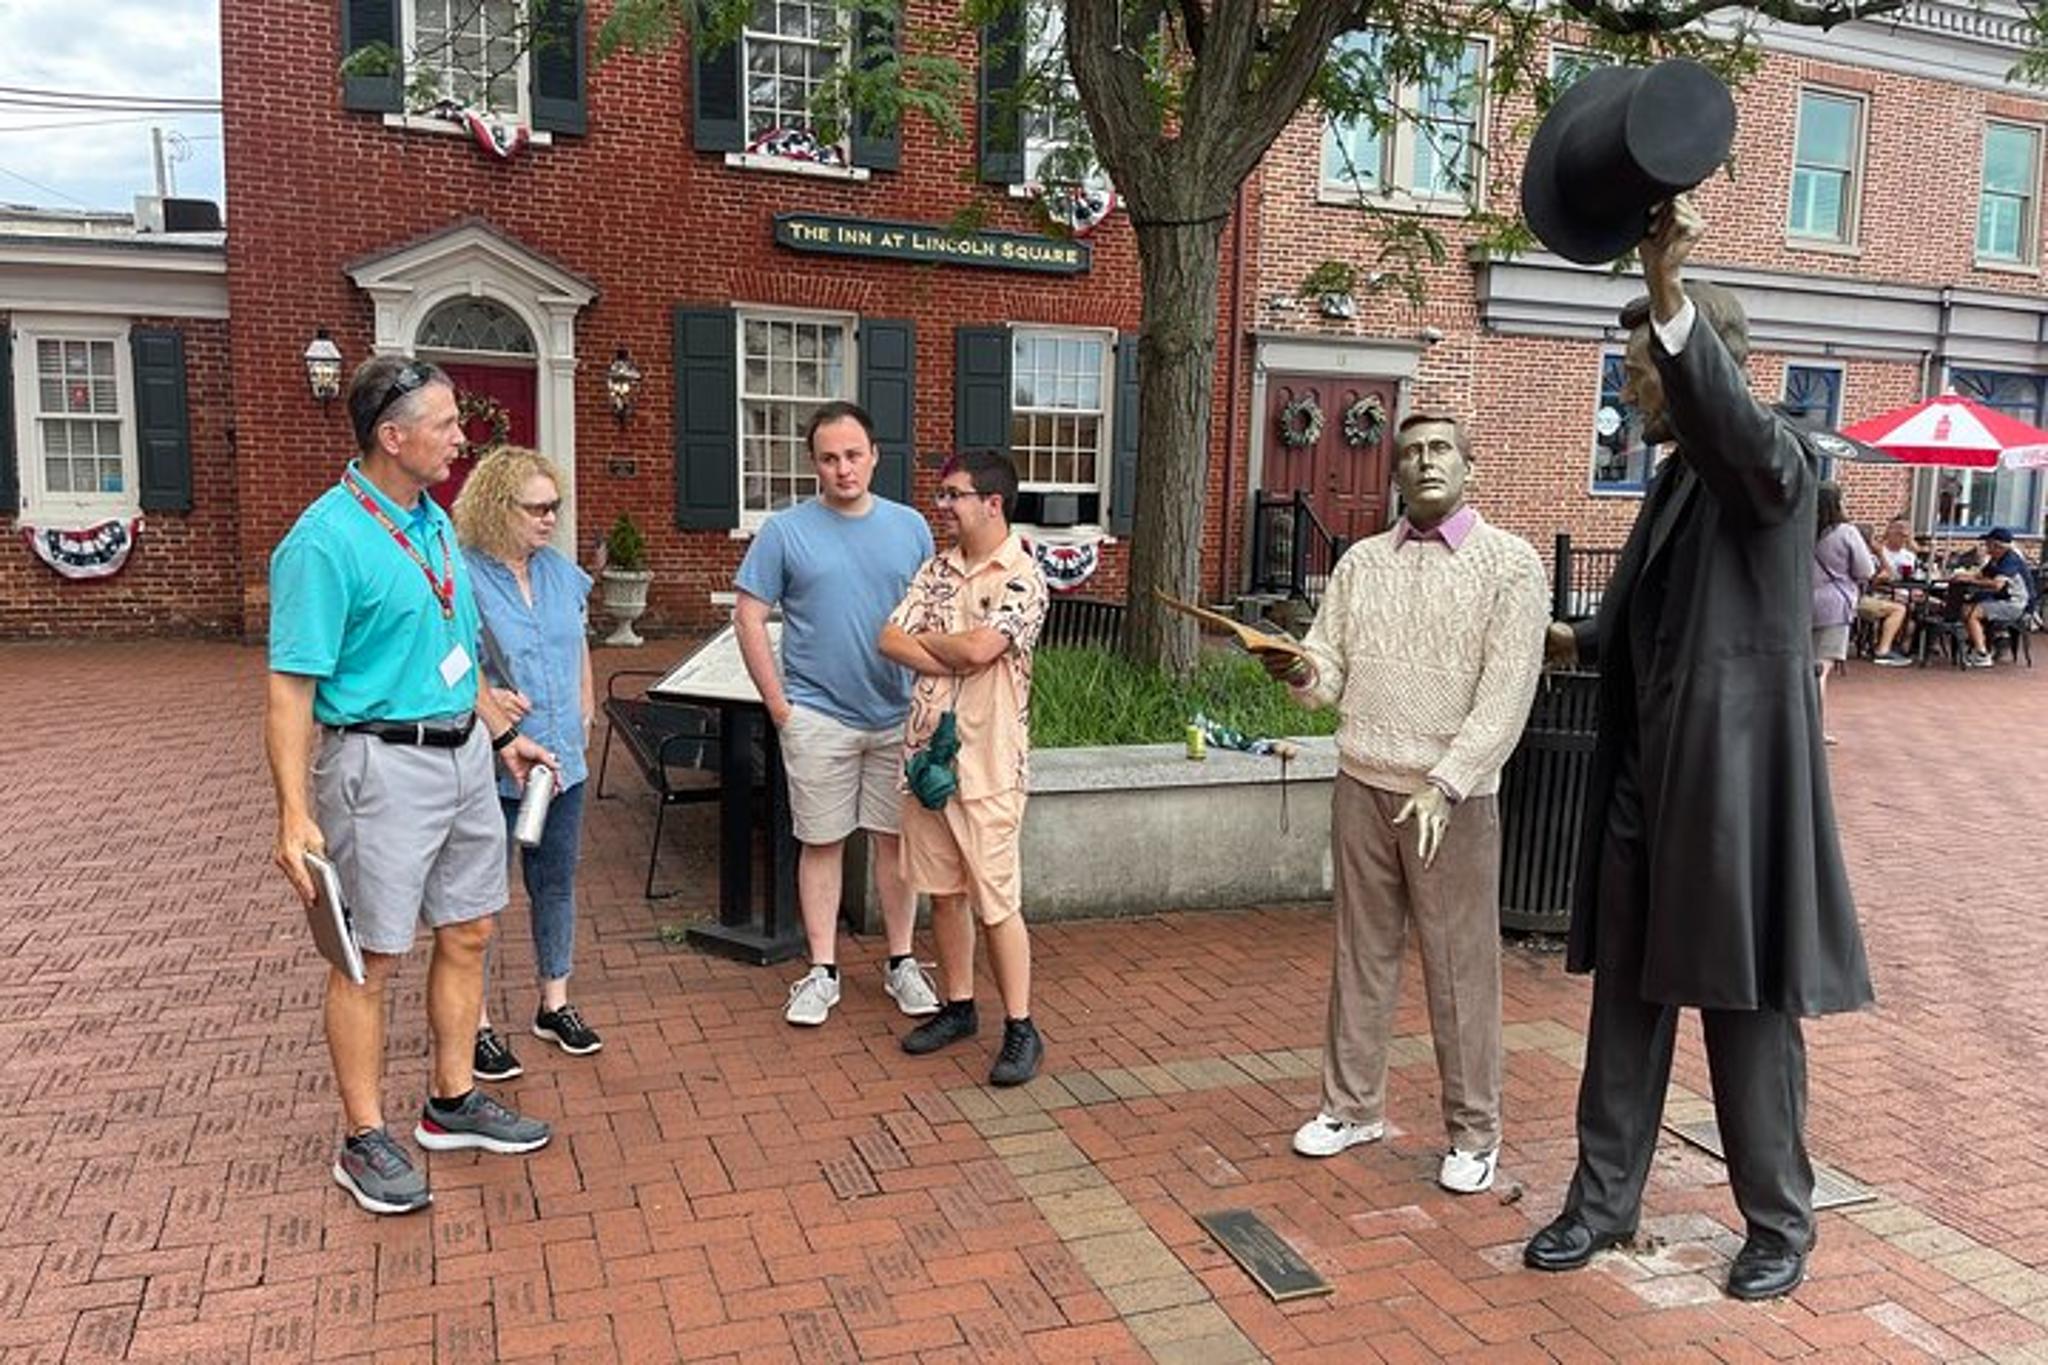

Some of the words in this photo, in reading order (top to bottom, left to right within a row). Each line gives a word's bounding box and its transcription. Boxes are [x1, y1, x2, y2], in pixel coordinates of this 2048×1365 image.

[787, 221, 831, 242] THE
[837, 226, 872, 246] INN
[880, 232, 906, 249] AT
[912, 232, 996, 257] LINCOLN
[1001, 241, 1079, 265] SQUARE
